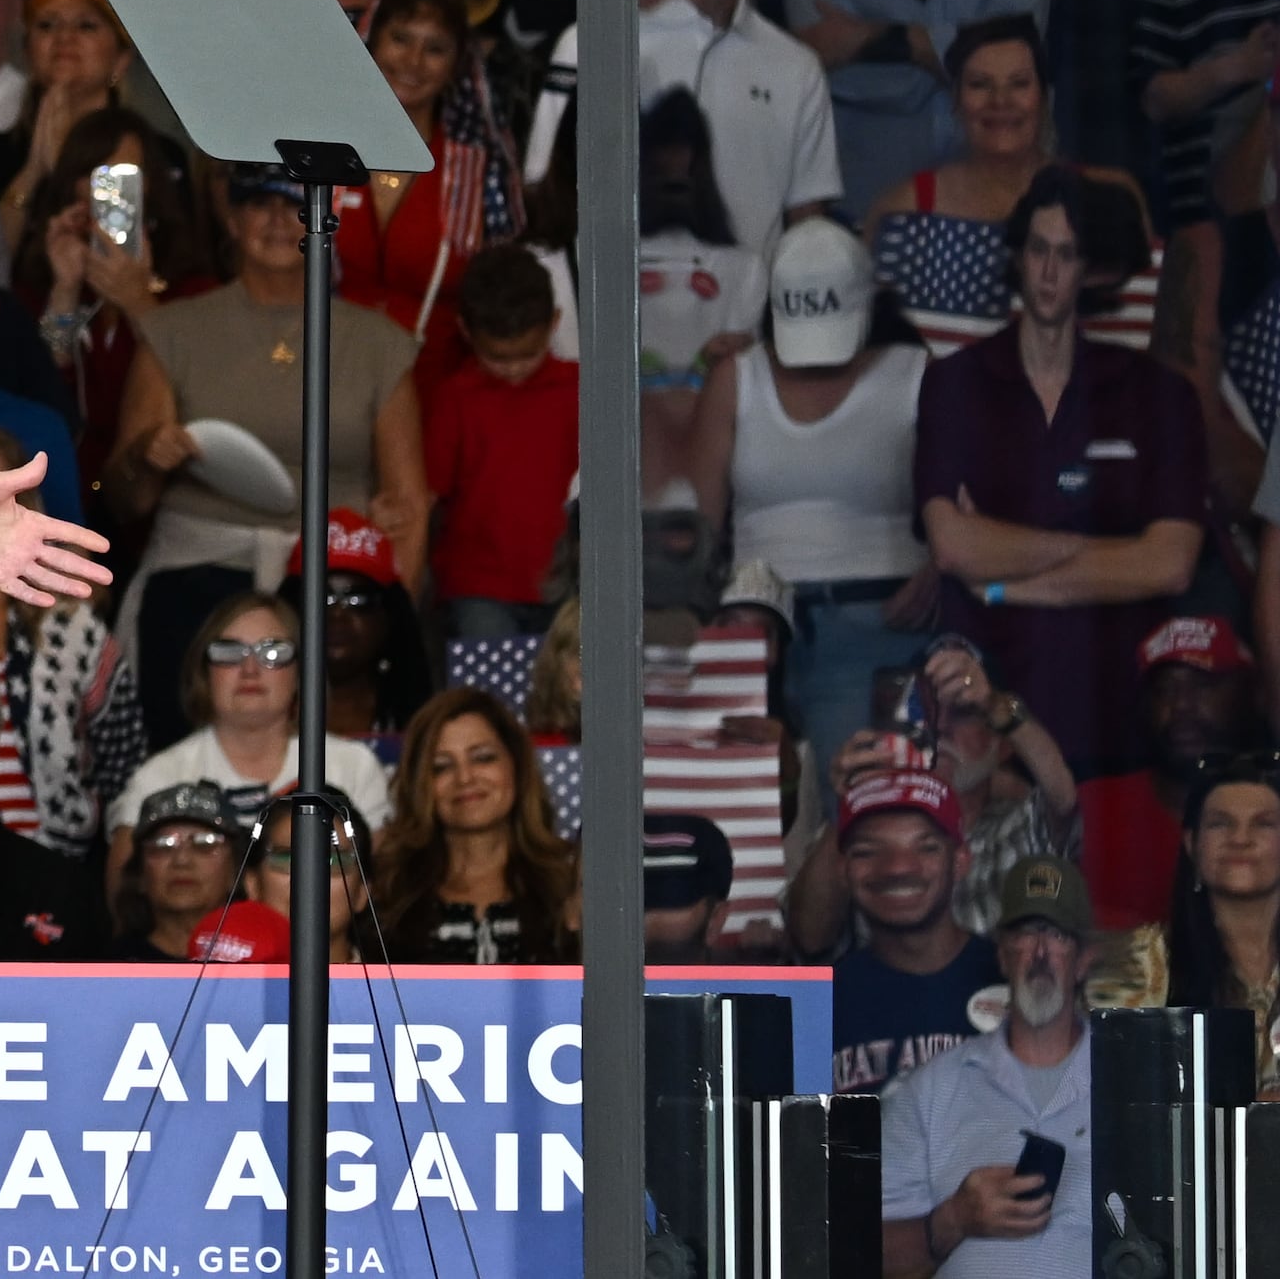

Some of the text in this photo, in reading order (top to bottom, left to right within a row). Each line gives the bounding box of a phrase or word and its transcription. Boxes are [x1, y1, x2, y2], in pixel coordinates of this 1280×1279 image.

[782, 286, 842, 319] USA
[103, 1022, 583, 1105] AMERIC
[204, 1130, 583, 1212] AGAIN
[7, 1245, 386, 1277] DALTON, GEOGIA
